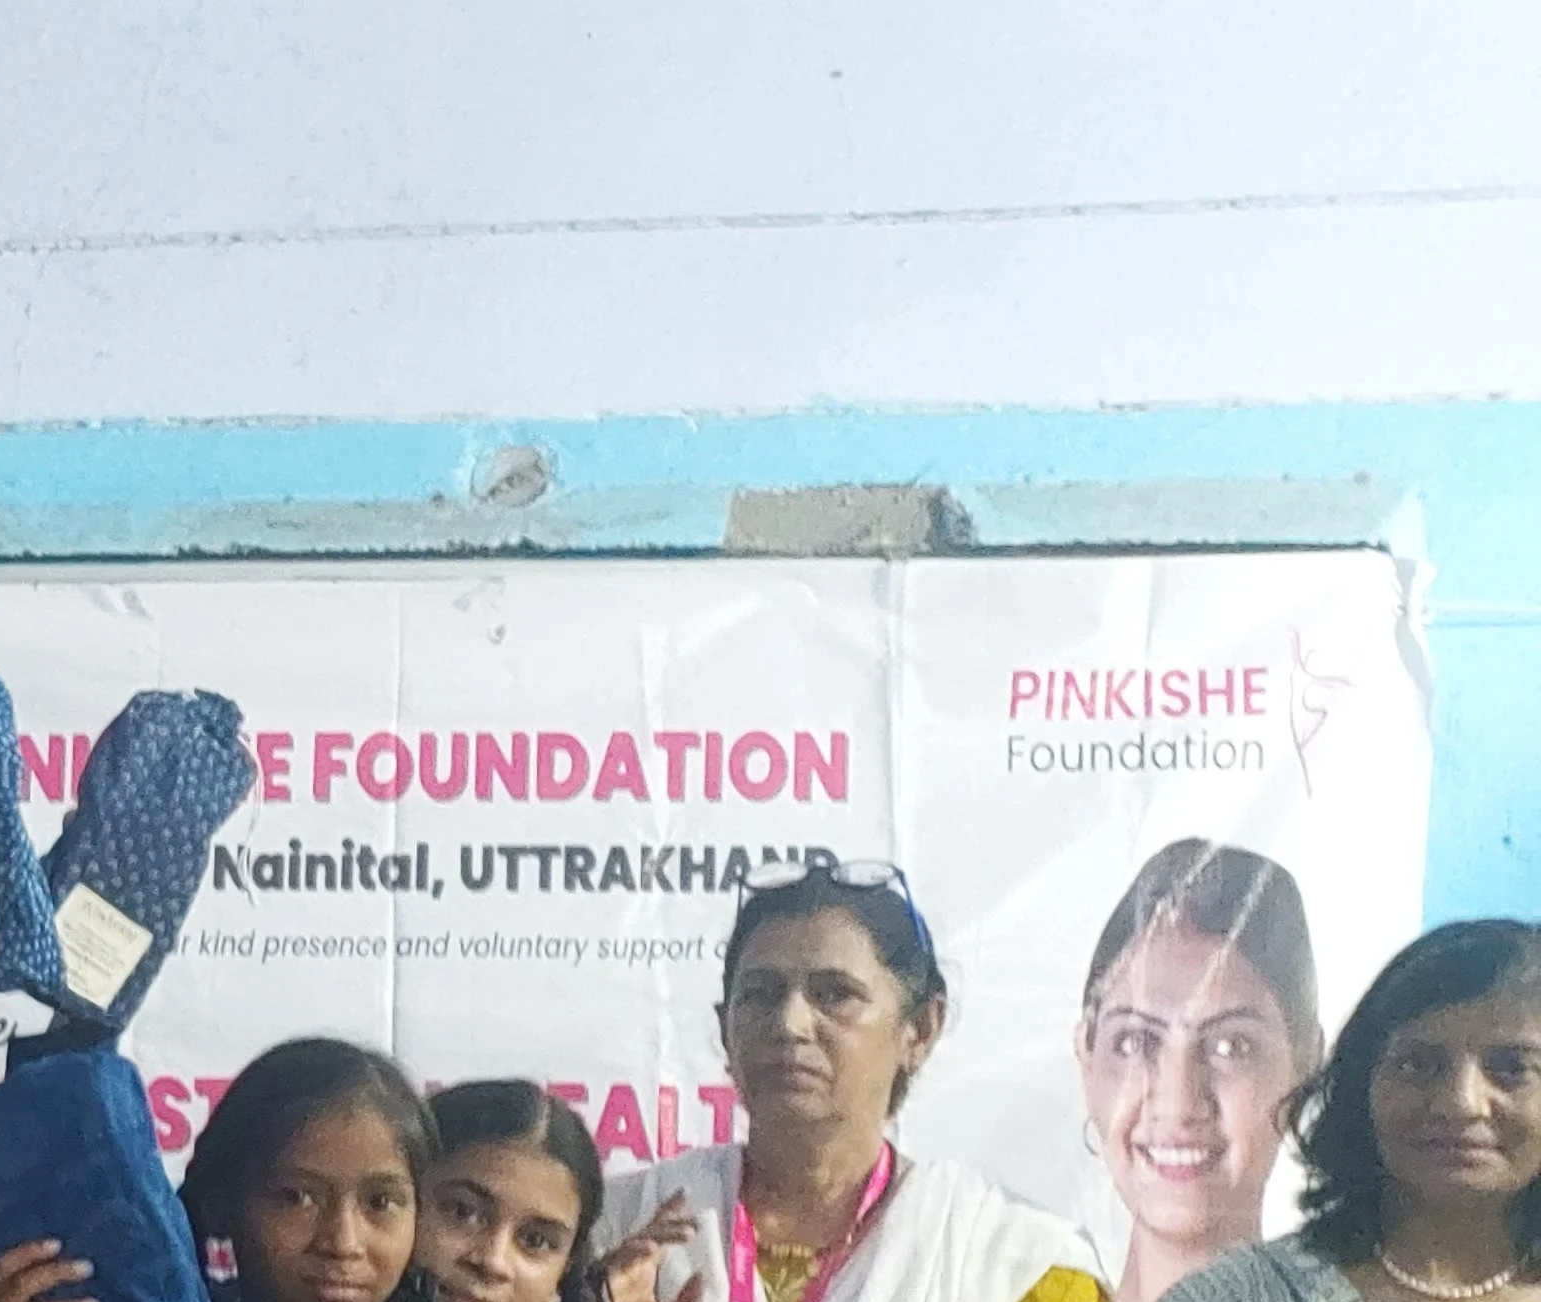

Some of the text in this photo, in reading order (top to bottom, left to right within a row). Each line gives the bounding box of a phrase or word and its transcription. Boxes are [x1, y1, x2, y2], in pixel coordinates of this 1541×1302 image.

[1008, 666, 1269, 721] PINKISHE
[311, 730, 850, 804] FOUNDATION
[1007, 730, 1265, 774] Foundation
[213, 837, 445, 899] Nainital,
[199, 928, 255, 957] kind
[261, 935, 387, 964] presence
[396, 928, 448, 959] and
[459, 930, 588, 967] voluntary
[598, 931, 704, 966] support
